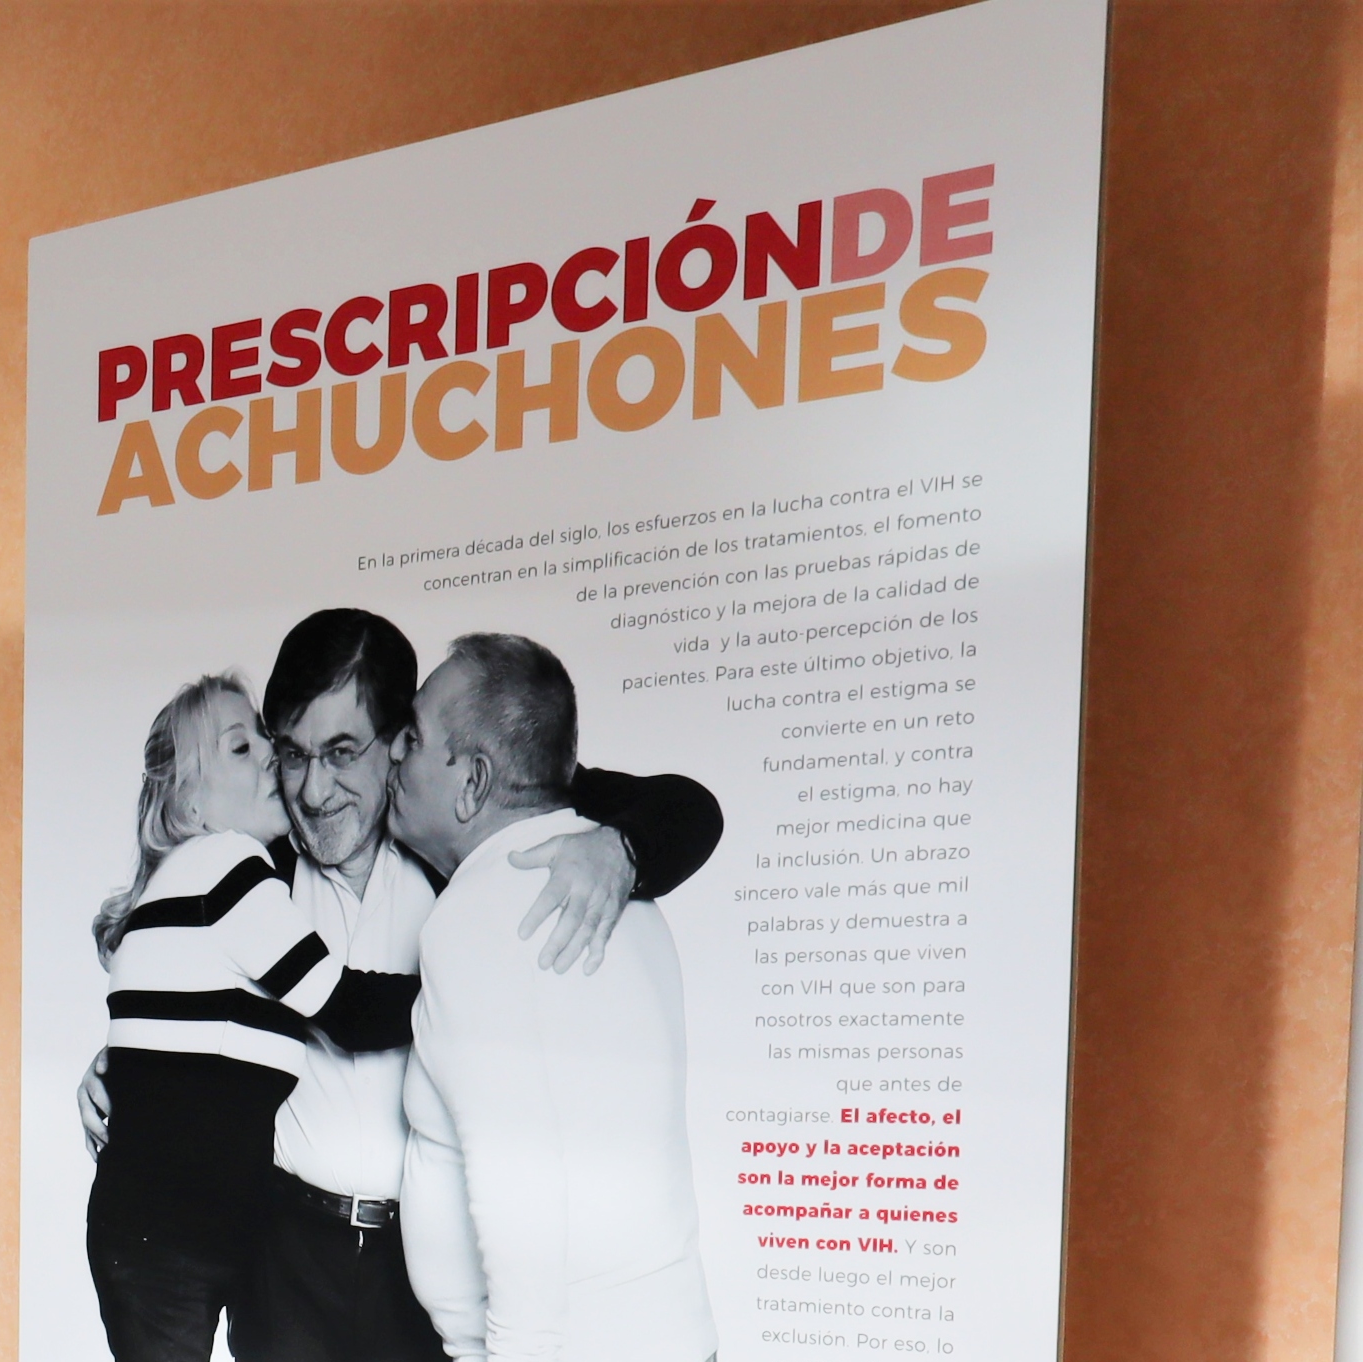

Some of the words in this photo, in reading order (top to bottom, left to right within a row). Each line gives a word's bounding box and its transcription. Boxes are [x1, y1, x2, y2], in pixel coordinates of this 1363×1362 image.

[96, 267, 988, 517] ACHUCHONES
[357, 555, 377, 572] En
[382, 551, 395, 568] la
[399, 545, 460, 570] primera
[464, 533, 524, 557] década
[528, 528, 555, 548] del
[559, 523, 604, 546] siglo,
[606, 519, 631, 539] los
[634, 510, 717, 534] esfuerzos
[722, 506, 745, 521] en
[751, 500, 767, 518] la
[772, 493, 824, 515] lucha
[829, 487, 890, 507] contra
[896, 478, 914, 498] el
[919, 474, 955, 494] VIH
[961, 474, 983, 489] se
[423, 566, 513, 592] concentran
[517, 565, 538, 580] en
[543, 559, 557, 577] la
[562, 544, 680, 575] simplificación
[685, 540, 709, 558] de
[714, 537, 739, 555] los
[744, 523, 867, 551] tratamientos,
[873, 515, 890, 534] el
[897, 507, 982, 531] fomento
[575, 585, 598, 603] de
[603, 582, 618, 600] la
[623, 570, 720, 602] prevención
[724, 569, 758, 585] con
[764, 563, 789, 581] las
[794, 554, 871, 581] pruebas
[877, 543, 949, 569] rápidas
[954, 538, 981, 558] de
[610, 605, 711, 631] diagnóstico
[715, 604, 727, 622] y
[731, 599, 747, 617] la
[753, 593, 817, 615] mejora
[822, 587, 848, 606] de
[853, 585, 869, 603] la
[875, 575, 947, 600] calidad
[953, 572, 980, 592] de
[673, 634, 710, 654] vida
[719, 636, 731, 654] y
[735, 630, 751, 648] la
[756, 614, 913, 646] auto-percepción
[919, 610, 946, 629] de
[951, 607, 979, 626] los
[622, 670, 709, 695] pacientes.
[715, 665, 755, 682] Para
[759, 660, 798, 677] este
[803, 654, 866, 674] último
[871, 644, 954, 669] objetivo,
[960, 640, 977, 658] la
[726, 693, 776, 713] lucha
[781, 689, 841, 707] contra
[847, 683, 864, 702] el
[869, 680, 948, 701] estigma
[954, 678, 976, 693] se
[781, 719, 867, 740] convierte
[872, 718, 897, 733] en
[903, 715, 929, 730] un
[935, 710, 975, 728] reto
[762, 747, 889, 773] fundamental,
[893, 750, 906, 768] y
[910, 744, 973, 763] contra
[797, 785, 814, 803] el
[819, 782, 900, 803] estigma,
[906, 782, 932, 796] no
[938, 776, 974, 797] hay
[776, 817, 831, 839] mejor
[836, 813, 926, 833] medicina
[932, 812, 972, 831] que
[756, 852, 771, 870] la
[777, 848, 863, 869] inclusión.
[871, 847, 898, 864] Un
[904, 844, 971, 862] abrazo
[733, 885, 799, 902] sincero
[804, 881, 841, 899] vale
[847, 879, 887, 898] más
[892, 881, 932, 900] que
[938, 875, 969, 894] mil
[754, 1013, 833, 1028] nosotros
[838, 1011, 965, 1027] exactamente
[835, 1079, 873, 1095] que
[878, 1077, 931, 1092] antes
[937, 1075, 963, 1093] de
[725, 1107, 834, 1127] contagiarse.
[840, 1107, 860, 1124] El
[865, 1107, 936, 1127] afecto,
[941, 1108, 962, 1126] el
[740, 1141, 801, 1159] apoyo
[804, 1142, 818, 1160] y
[823, 1138, 842, 1156] la
[846, 1140, 961, 1161] aceptación
[737, 1172, 772, 1186] son
[777, 1169, 795, 1187] la
[800, 1169, 860, 1192] mejor
[865, 1171, 928, 1191] forma
[933, 1174, 960, 1192] de
[742, 1201, 854, 1222] acompañar
[858, 1207, 871, 1221] a
[875, 1204, 959, 1226] quienes
[757, 1231, 810, 1250] viven
[815, 1238, 852, 1252] con
[857, 1236, 899, 1254] VIH.
[904, 1239, 917, 1254] Y
[923, 1243, 957, 1257] son
